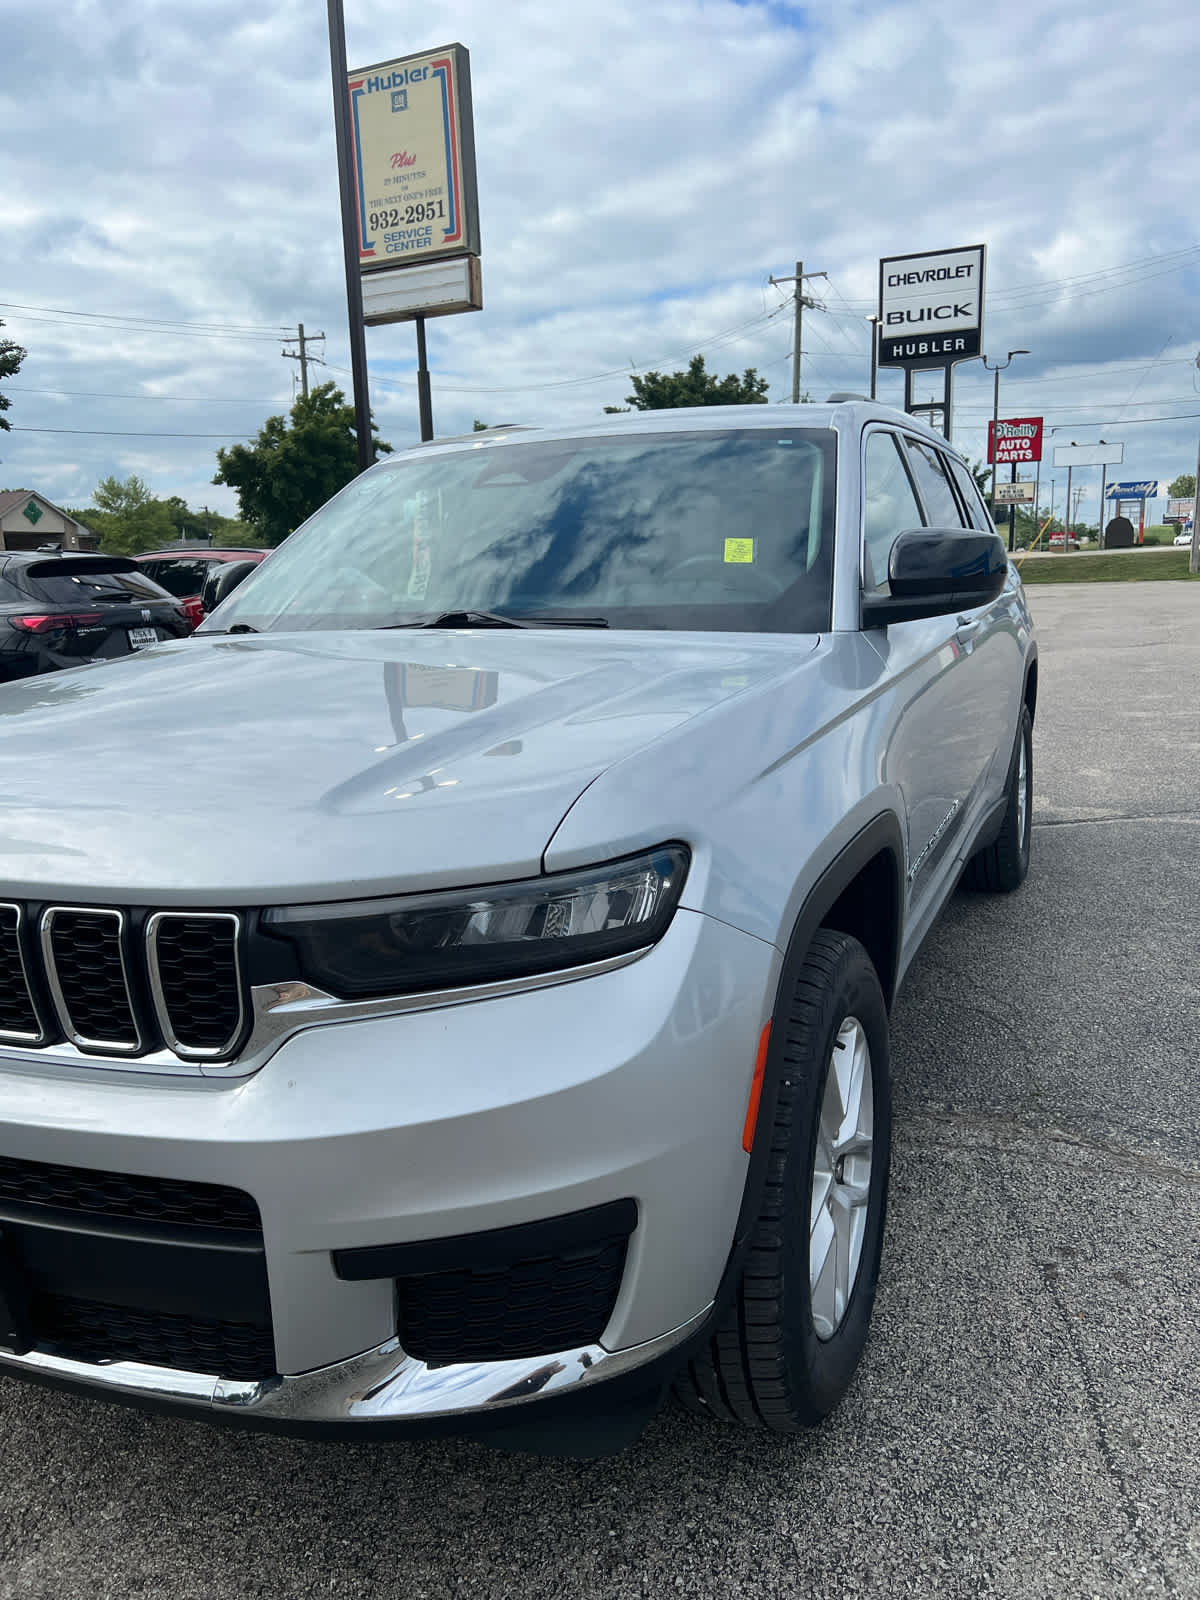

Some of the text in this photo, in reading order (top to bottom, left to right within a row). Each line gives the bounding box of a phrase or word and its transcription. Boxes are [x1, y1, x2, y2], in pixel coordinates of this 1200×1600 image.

[367, 66, 429, 94] Hubler
[390, 151, 417, 168] Plus
[393, 170, 427, 184] MINUTES
[368, 198, 384, 208] THE
[384, 195, 402, 206] NEXT
[424, 186, 443, 199] FREE
[369, 199, 446, 231] 932-2951
[384, 225, 432, 243] SERVICE
[385, 236, 432, 254] CENTER
[888, 264, 974, 287] CHEVROLET
[886, 302, 973, 325] BUICK
[893, 338, 965, 357] HUBLER
[993, 423, 1038, 438] O'Reilly
[999, 438, 1031, 450] AUTO
[996, 449, 1033, 461] PARTS
